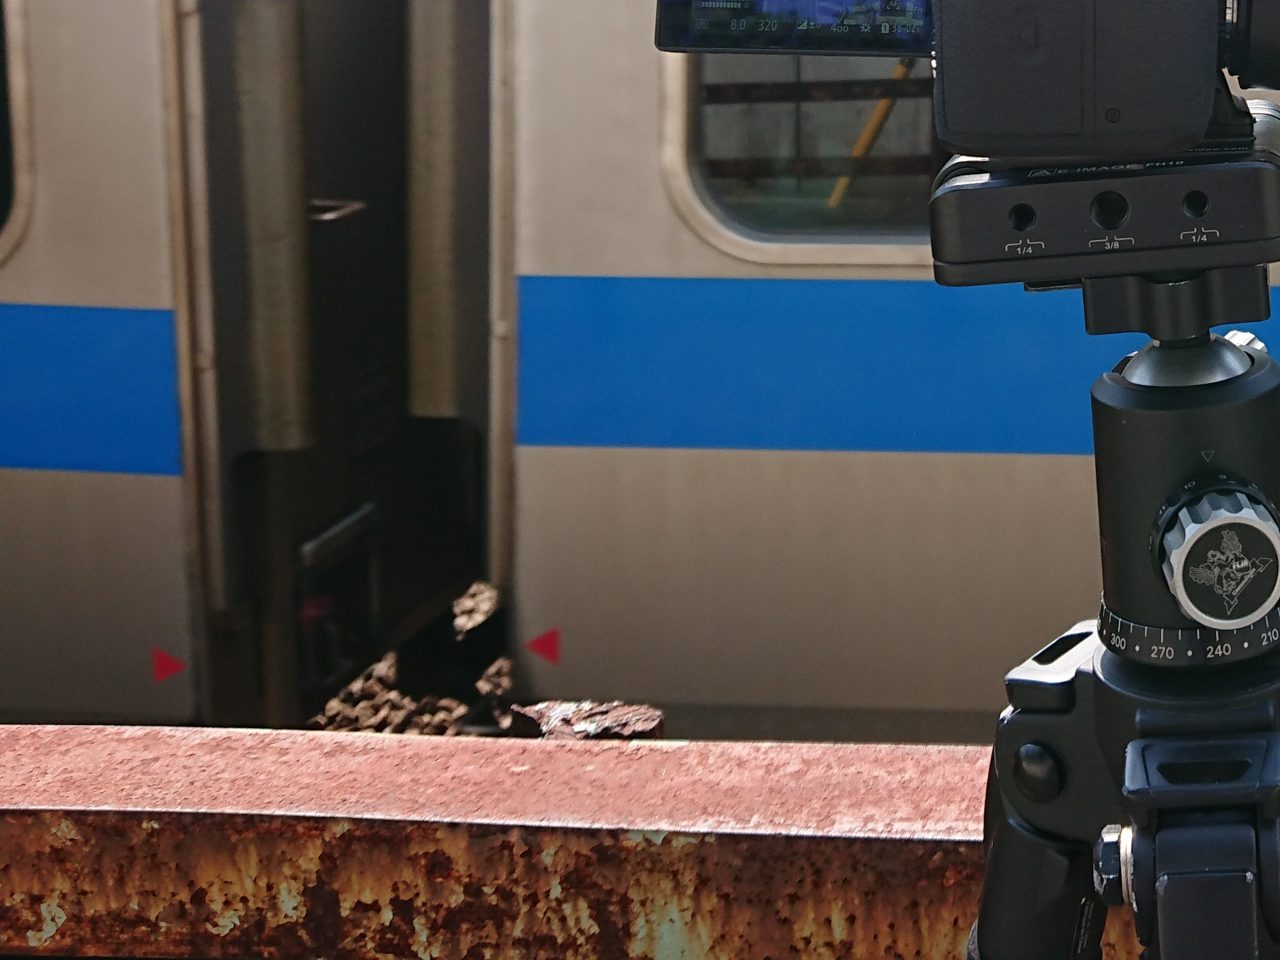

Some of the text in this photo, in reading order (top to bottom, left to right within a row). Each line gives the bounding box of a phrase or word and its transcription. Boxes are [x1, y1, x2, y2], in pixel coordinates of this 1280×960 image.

[758, 19, 777, 32] 320
[1192, 235, 1208, 243] 1/4
[1017, 246, 1033, 255] 1/4
[1105, 242, 1120, 250] 3/8
[1110, 633, 1126, 650] 300
[1150, 645, 1175, 660] 270
[1206, 643, 1232, 659] 240
[1260, 628, 1279, 646] 210
